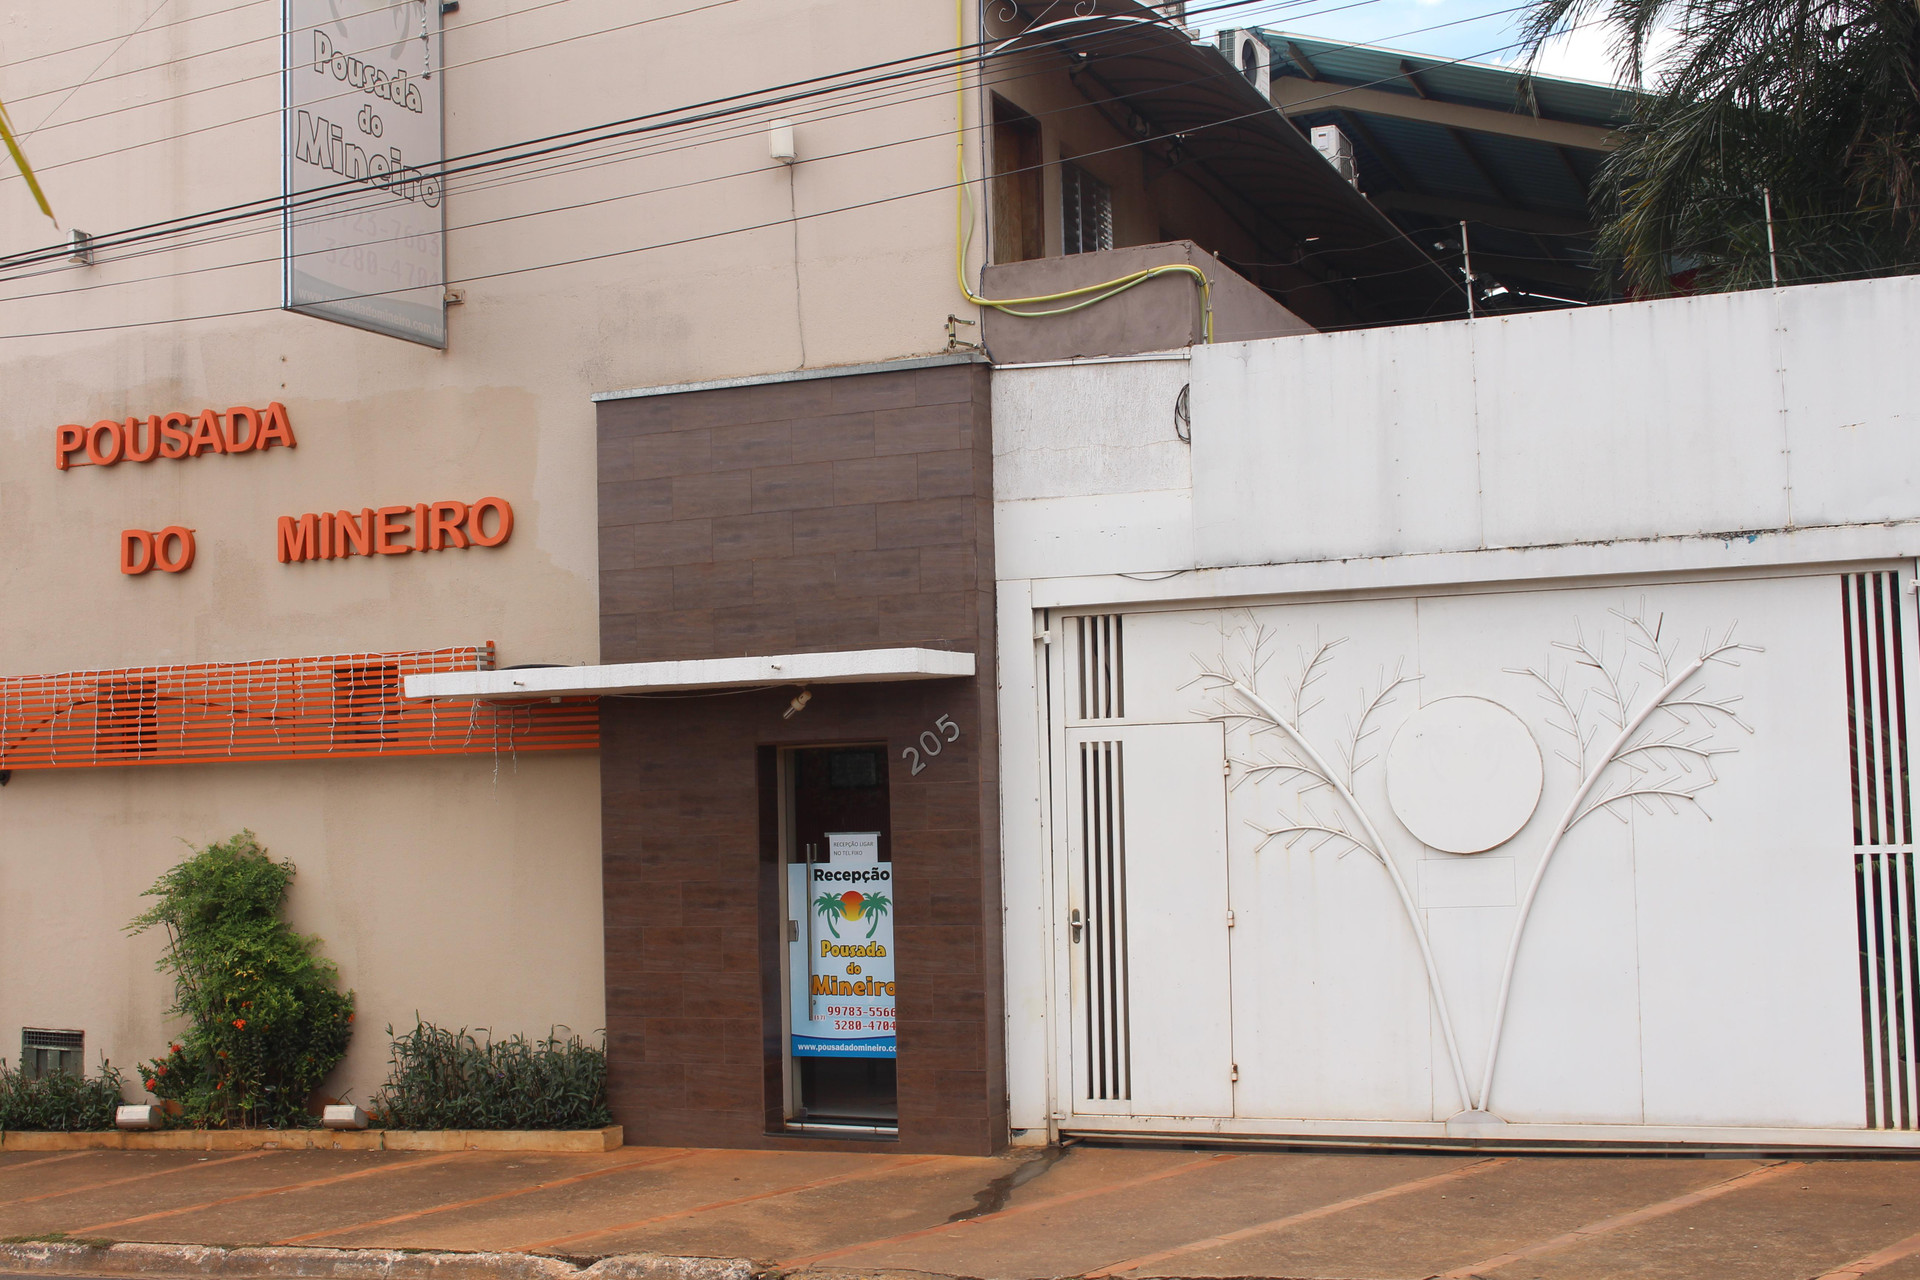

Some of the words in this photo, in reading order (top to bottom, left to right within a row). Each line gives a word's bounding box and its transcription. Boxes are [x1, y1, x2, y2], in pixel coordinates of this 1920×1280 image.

[313, 29, 423, 114] Pousada
[358, 103, 383, 138] do
[296, 109, 441, 208] Mineiro
[56, 401, 297, 472] POUSADA
[121, 525, 196, 575] DO
[277, 496, 514, 564] MINEIRO
[902, 713, 960, 776] 205
[813, 867, 891, 884] Recepção
[821, 940, 887, 958] Pousada
[846, 962, 862, 975] do
[812, 974, 896, 997] Mineiro
[827, 1006, 896, 1018] 99783-5566
[834, 1020, 896, 1031] 3280-4704
